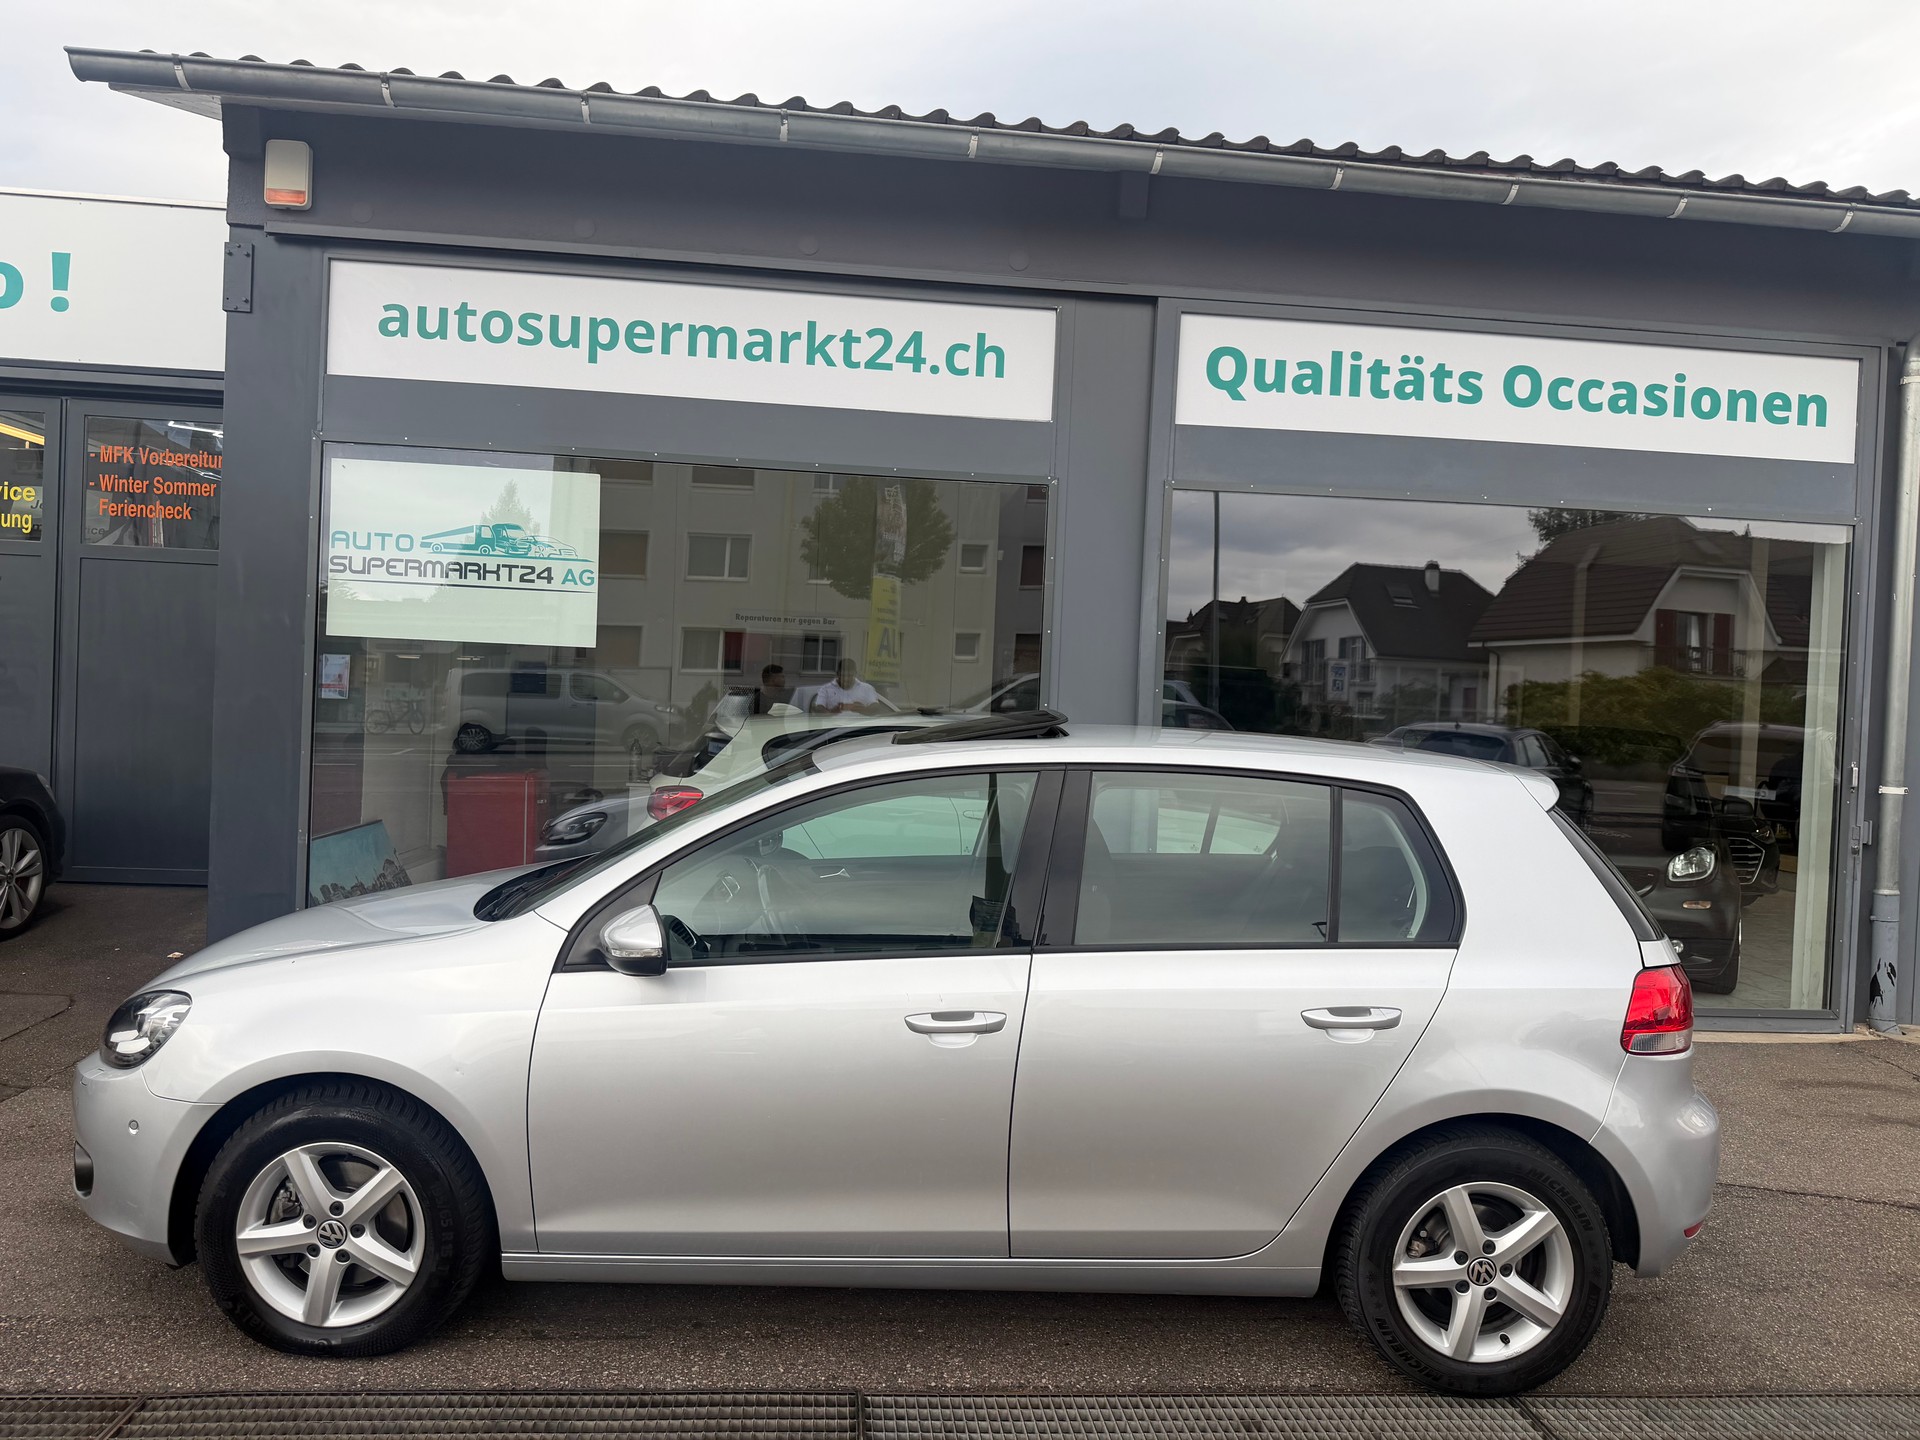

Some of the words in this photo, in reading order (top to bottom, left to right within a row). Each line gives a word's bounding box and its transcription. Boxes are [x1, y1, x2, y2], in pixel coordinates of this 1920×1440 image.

[378, 302, 1005, 379] autosupermarkt24.ch
[1206, 346, 1484, 403] Qualitäts
[1503, 365, 1828, 427] Occasionen
[100, 446, 134, 464] MFK
[99, 474, 149, 493] Winter
[153, 476, 217, 497] Sommer
[99, 499, 192, 520] Feriencheck
[331, 530, 414, 552] AUTO
[329, 555, 554, 584] SUPERMARKT24
[561, 568, 595, 586] AG
[736, 613, 781, 623] Reparaturen
[1527, 1166, 1594, 1233] MICHELIN
[1375, 1316, 1441, 1382] MICHELIN
